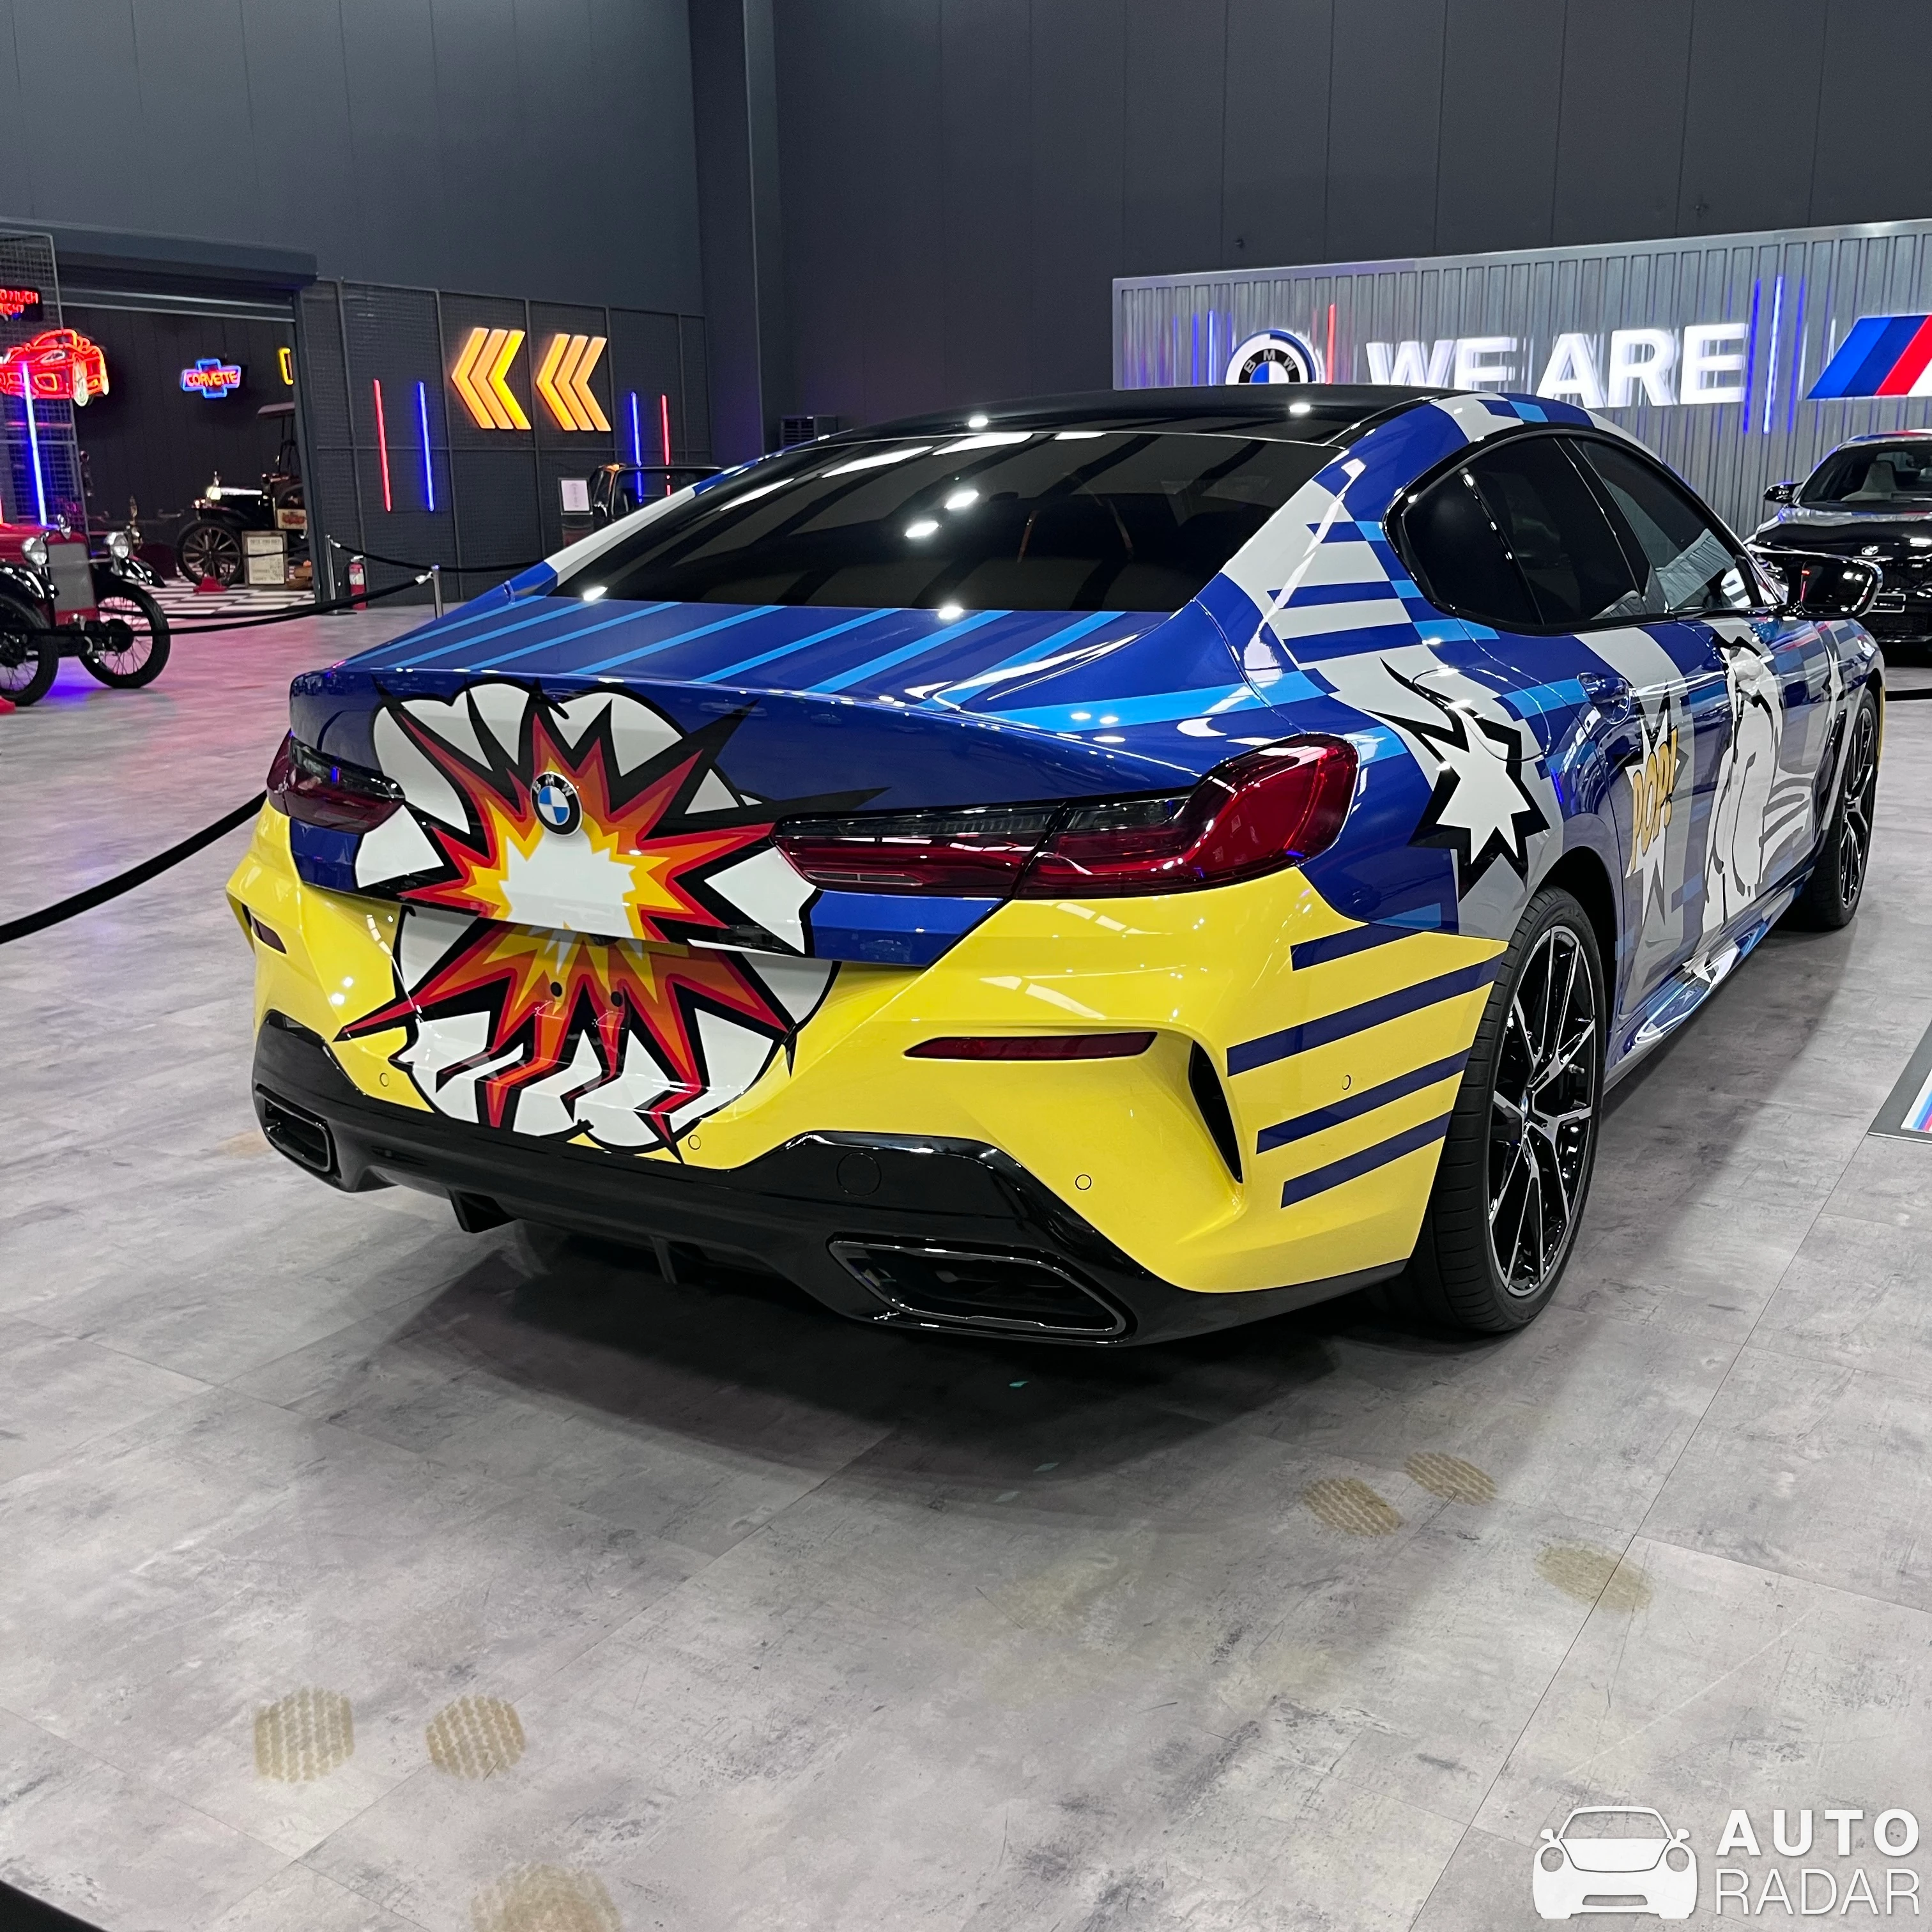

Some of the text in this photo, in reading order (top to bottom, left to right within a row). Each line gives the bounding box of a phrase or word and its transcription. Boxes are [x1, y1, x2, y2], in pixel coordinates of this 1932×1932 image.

[1243, 349, 1296, 374] BMW
[1366, 323, 1748, 409] WE ARE
[187, 372, 237, 387] CORVETTE
[532, 774, 574, 797] BMW
[1630, 725, 1678, 874] POP!
